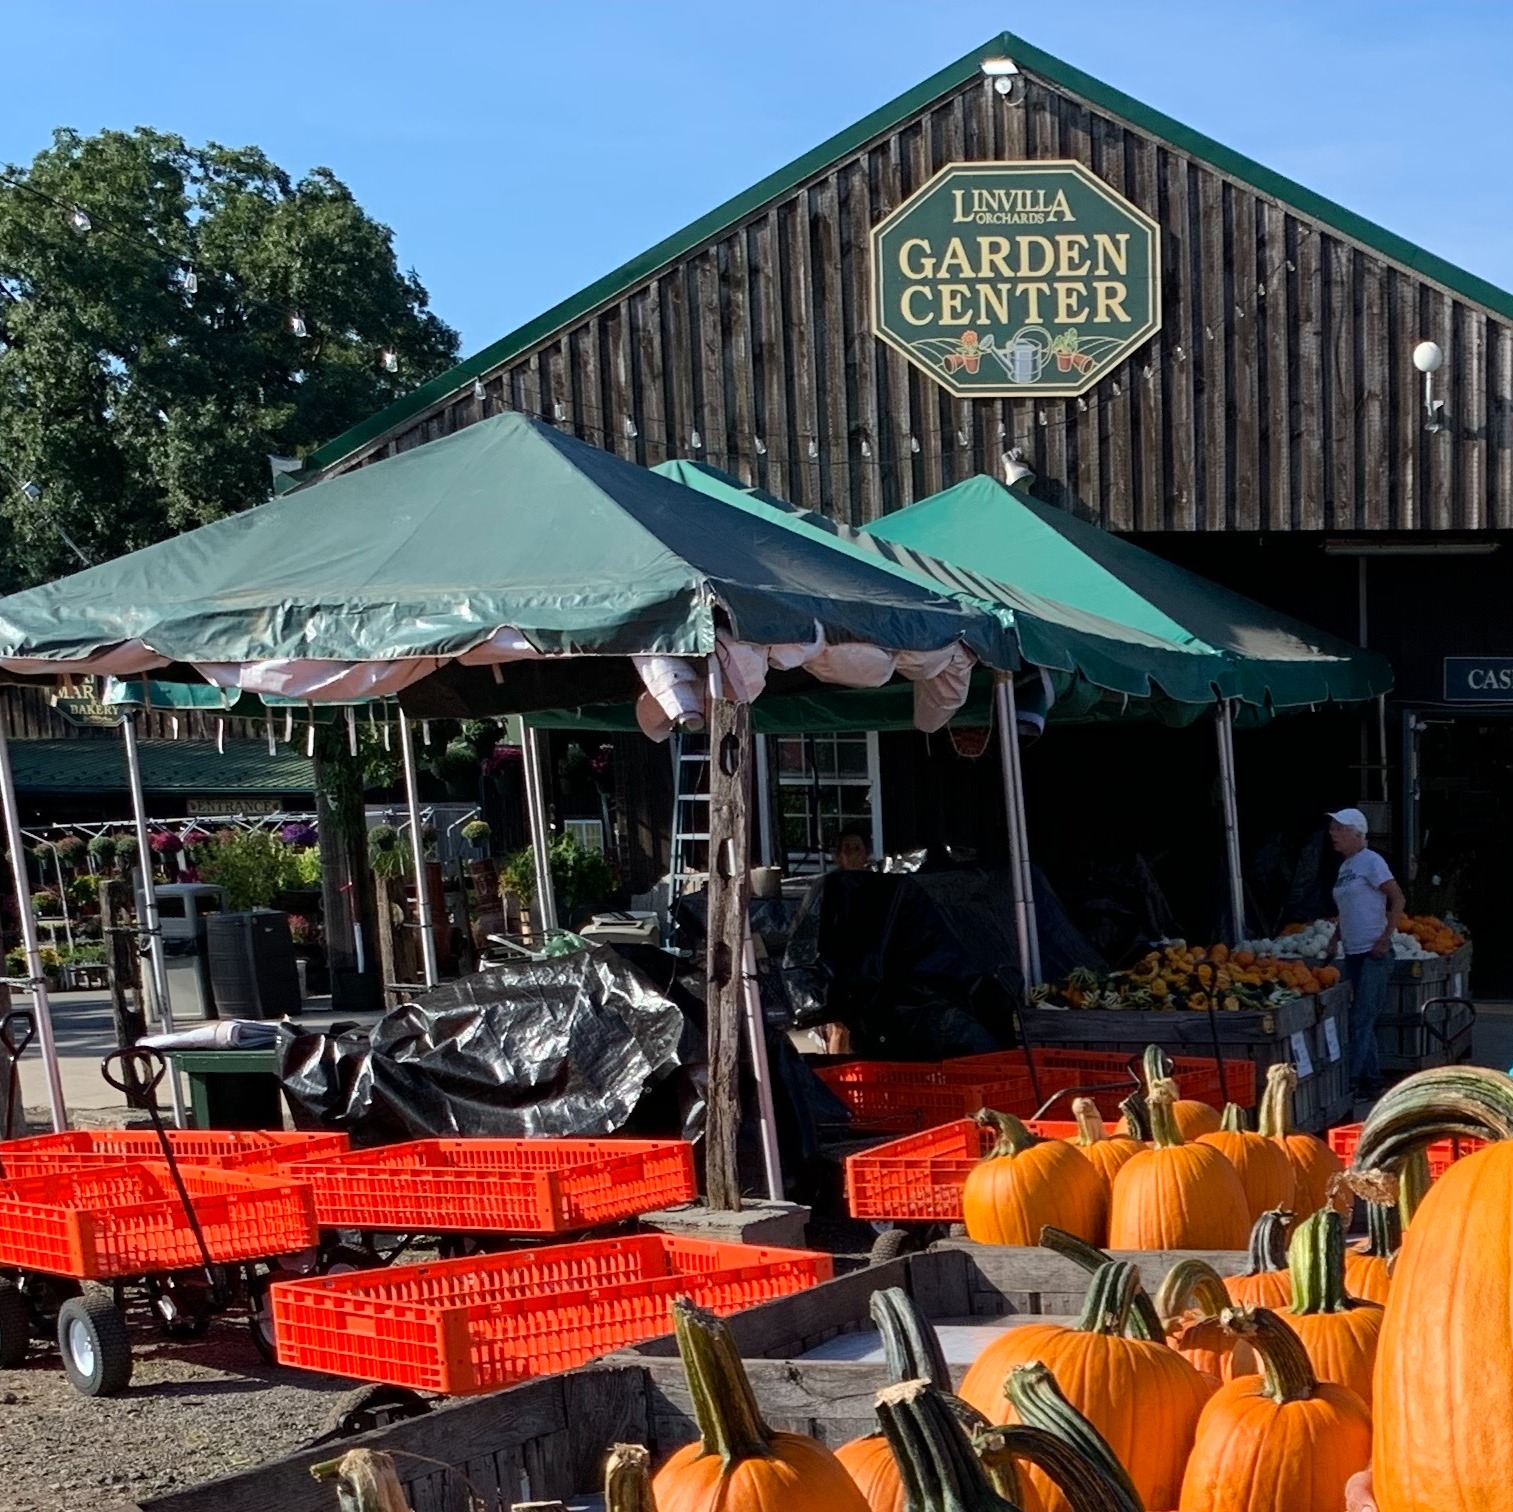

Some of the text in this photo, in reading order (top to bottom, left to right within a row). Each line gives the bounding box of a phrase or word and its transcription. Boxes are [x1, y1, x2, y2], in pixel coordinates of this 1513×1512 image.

[952, 188, 1076, 223] LINVILLA
[976, 212, 1044, 225] ORCHARDS
[898, 233, 1131, 280] GARDEN
[900, 281, 1132, 326] CENTER
[57, 684, 97, 701] MAR
[70, 703, 119, 715] BAKERY
[197, 800, 271, 812] ENTRANCE
